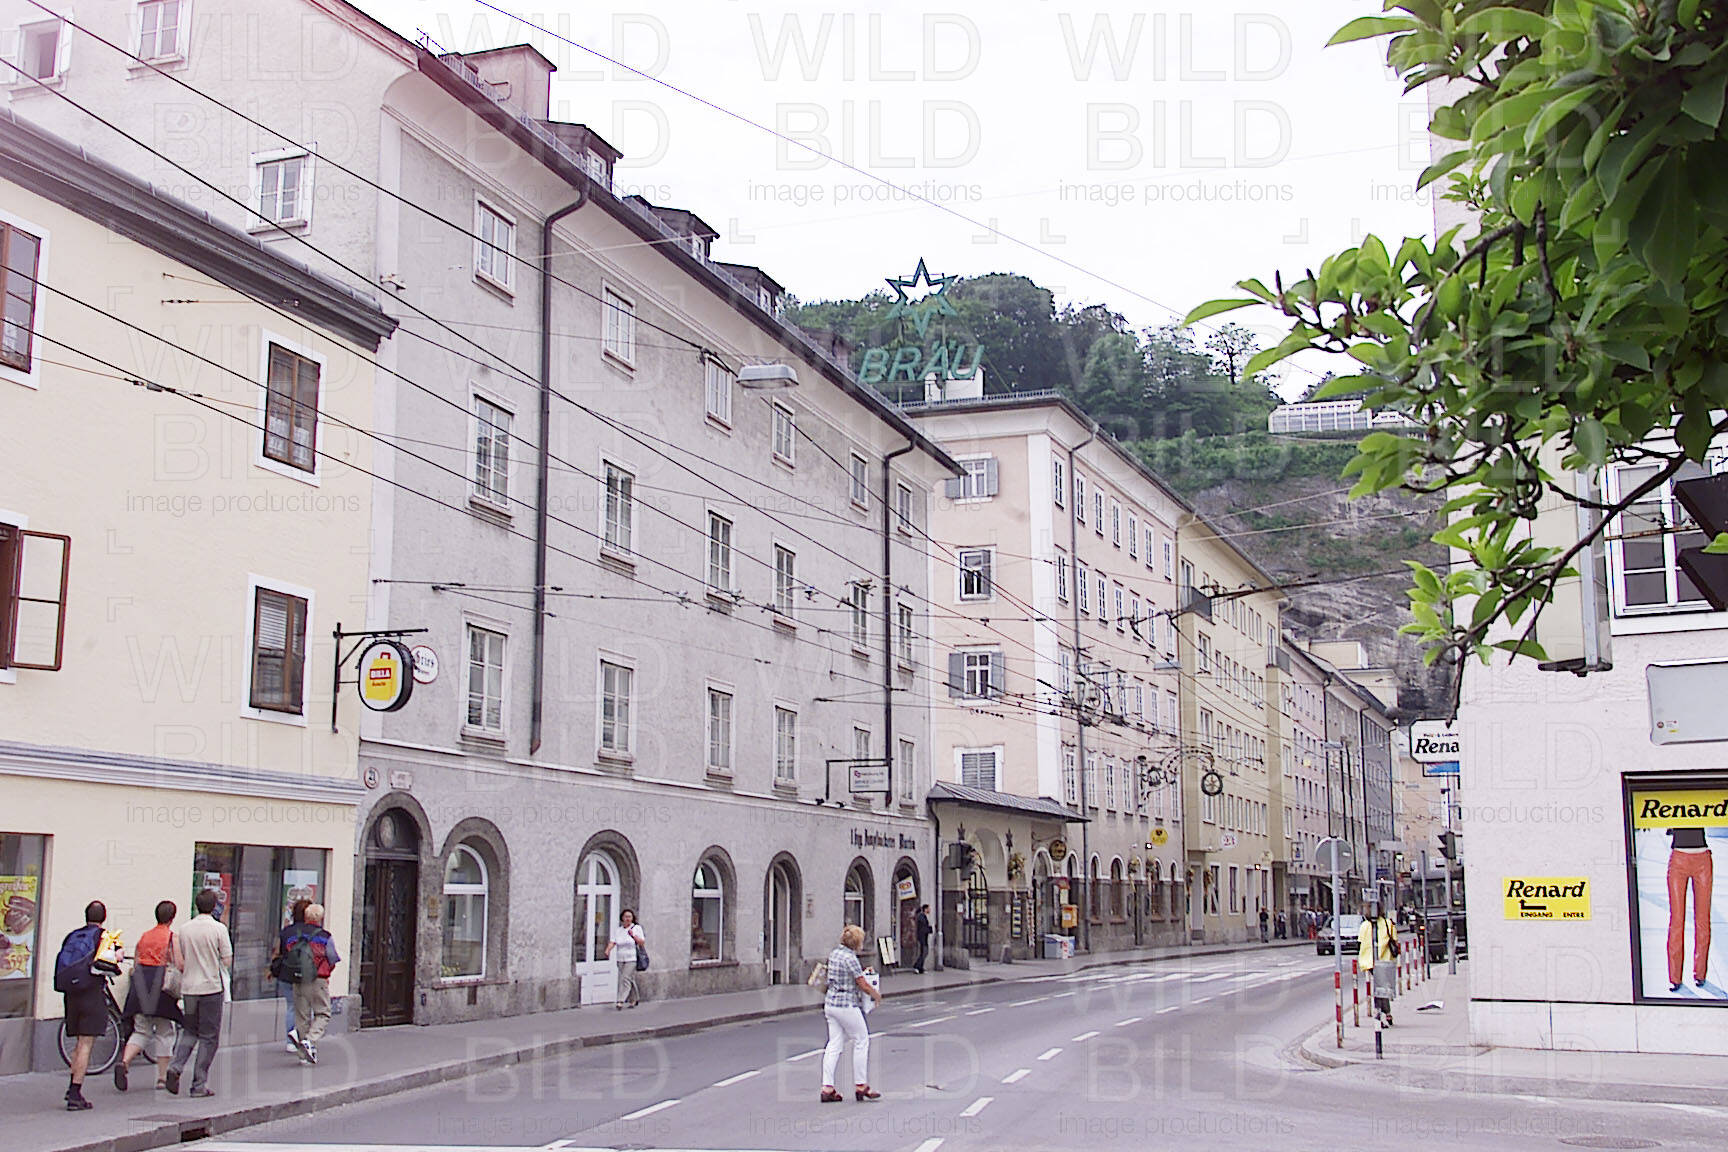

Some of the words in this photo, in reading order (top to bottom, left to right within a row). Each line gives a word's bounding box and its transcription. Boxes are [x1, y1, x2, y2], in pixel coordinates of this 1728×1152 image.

[859, 340, 984, 383] BRÄU
[1415, 738, 1460, 754] Rena
[1641, 799, 1728, 818] Renard
[1506, 880, 1586, 898] Renard
